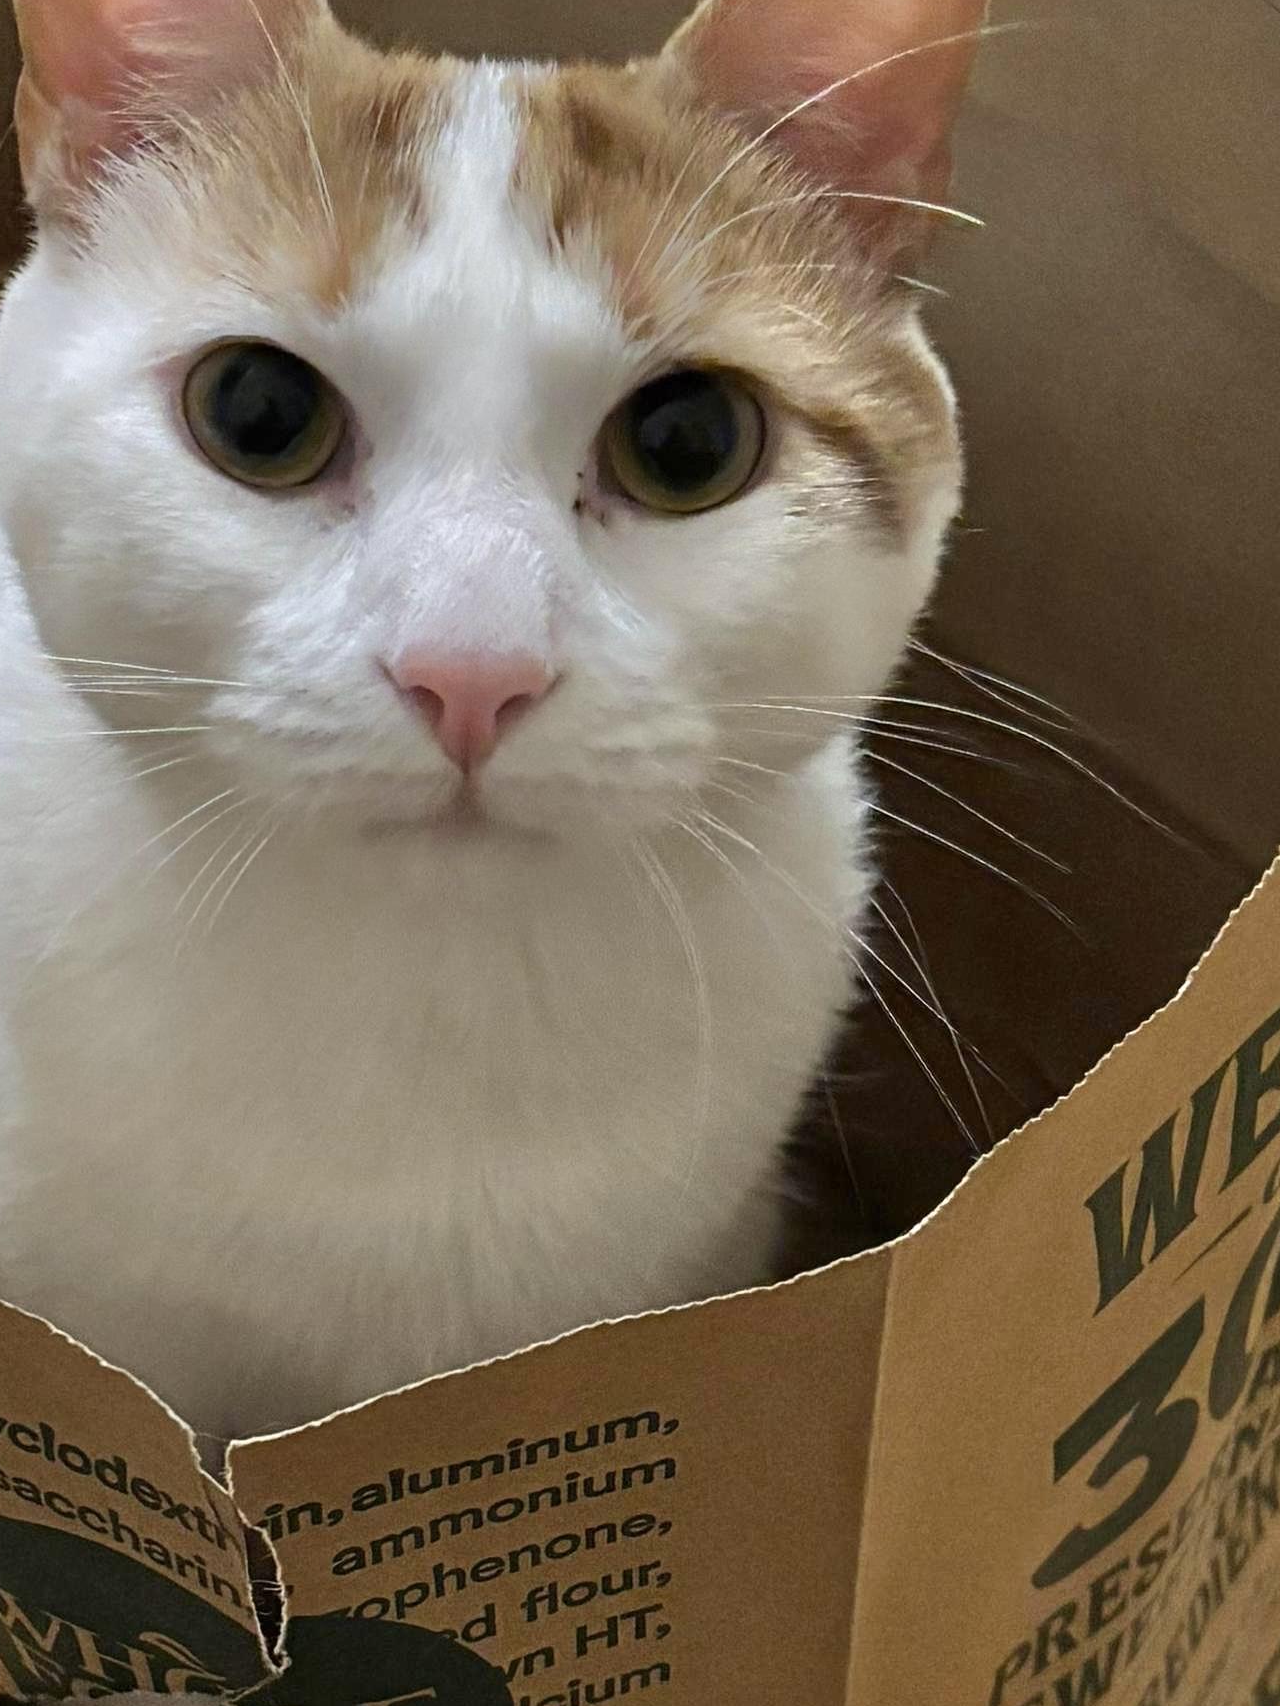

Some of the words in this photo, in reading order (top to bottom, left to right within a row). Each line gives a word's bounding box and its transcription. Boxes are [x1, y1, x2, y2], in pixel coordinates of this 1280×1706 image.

[352, 1408, 680, 1513] aluminum,
[332, 1456, 677, 1577] ammonium
[520, 1560, 673, 1623] flour,
[575, 1603, 673, 1659] HT,
